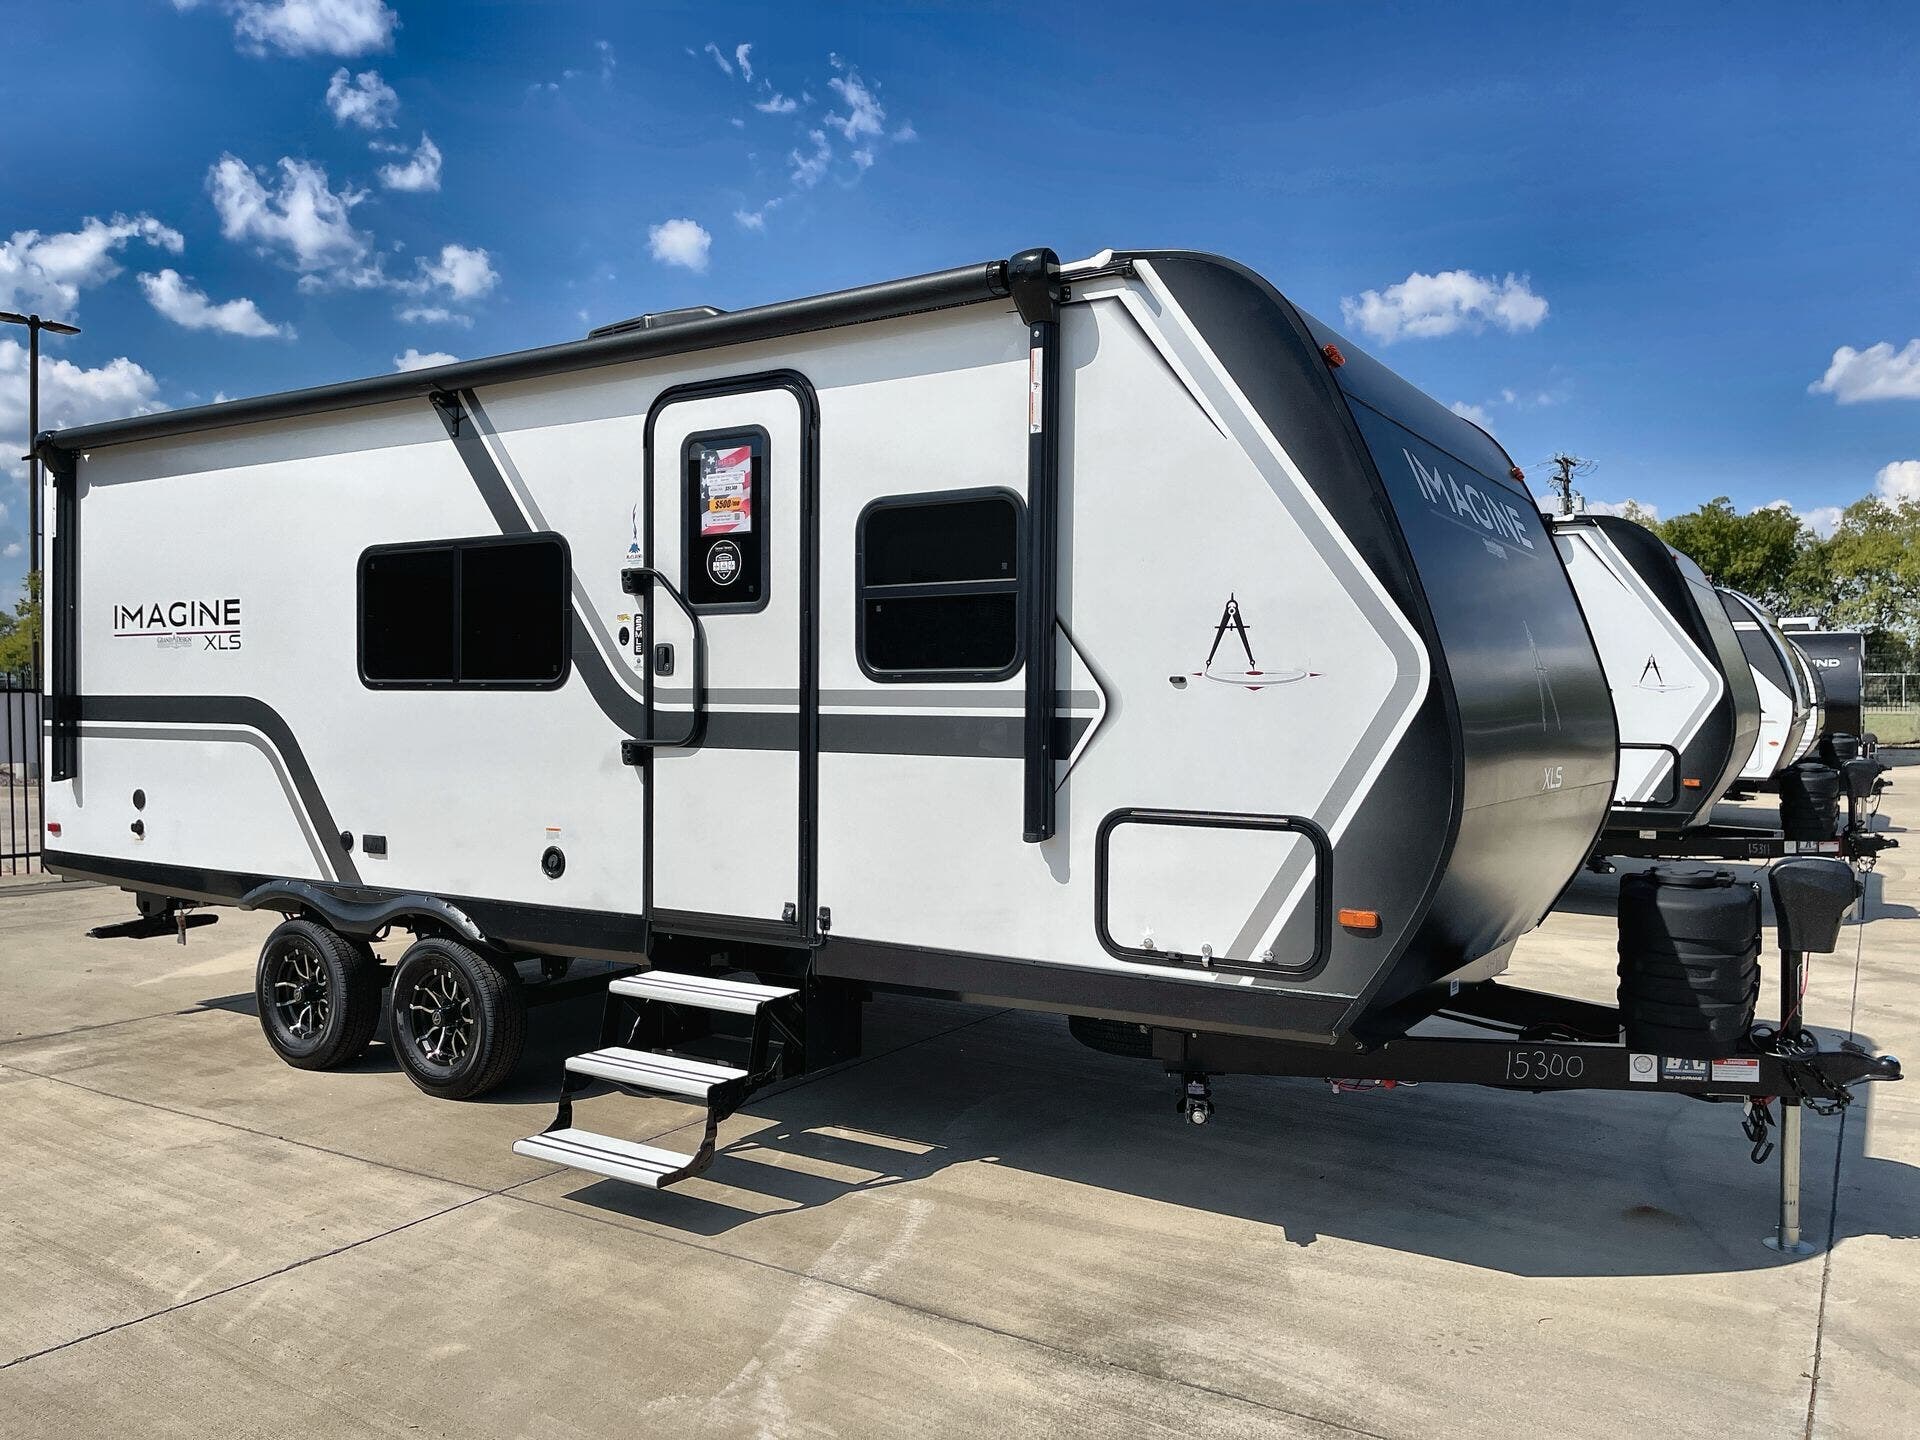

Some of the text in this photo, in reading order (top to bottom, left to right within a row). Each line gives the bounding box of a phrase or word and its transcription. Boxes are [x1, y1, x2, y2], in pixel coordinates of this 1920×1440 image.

[1402, 448, 1535, 549] IMAGINE
[114, 599, 240, 629] IMAGINE
[204, 635, 241, 650] XLS
[1542, 766, 1562, 790] XLS
[1506, 1051, 1584, 1080] 15300
